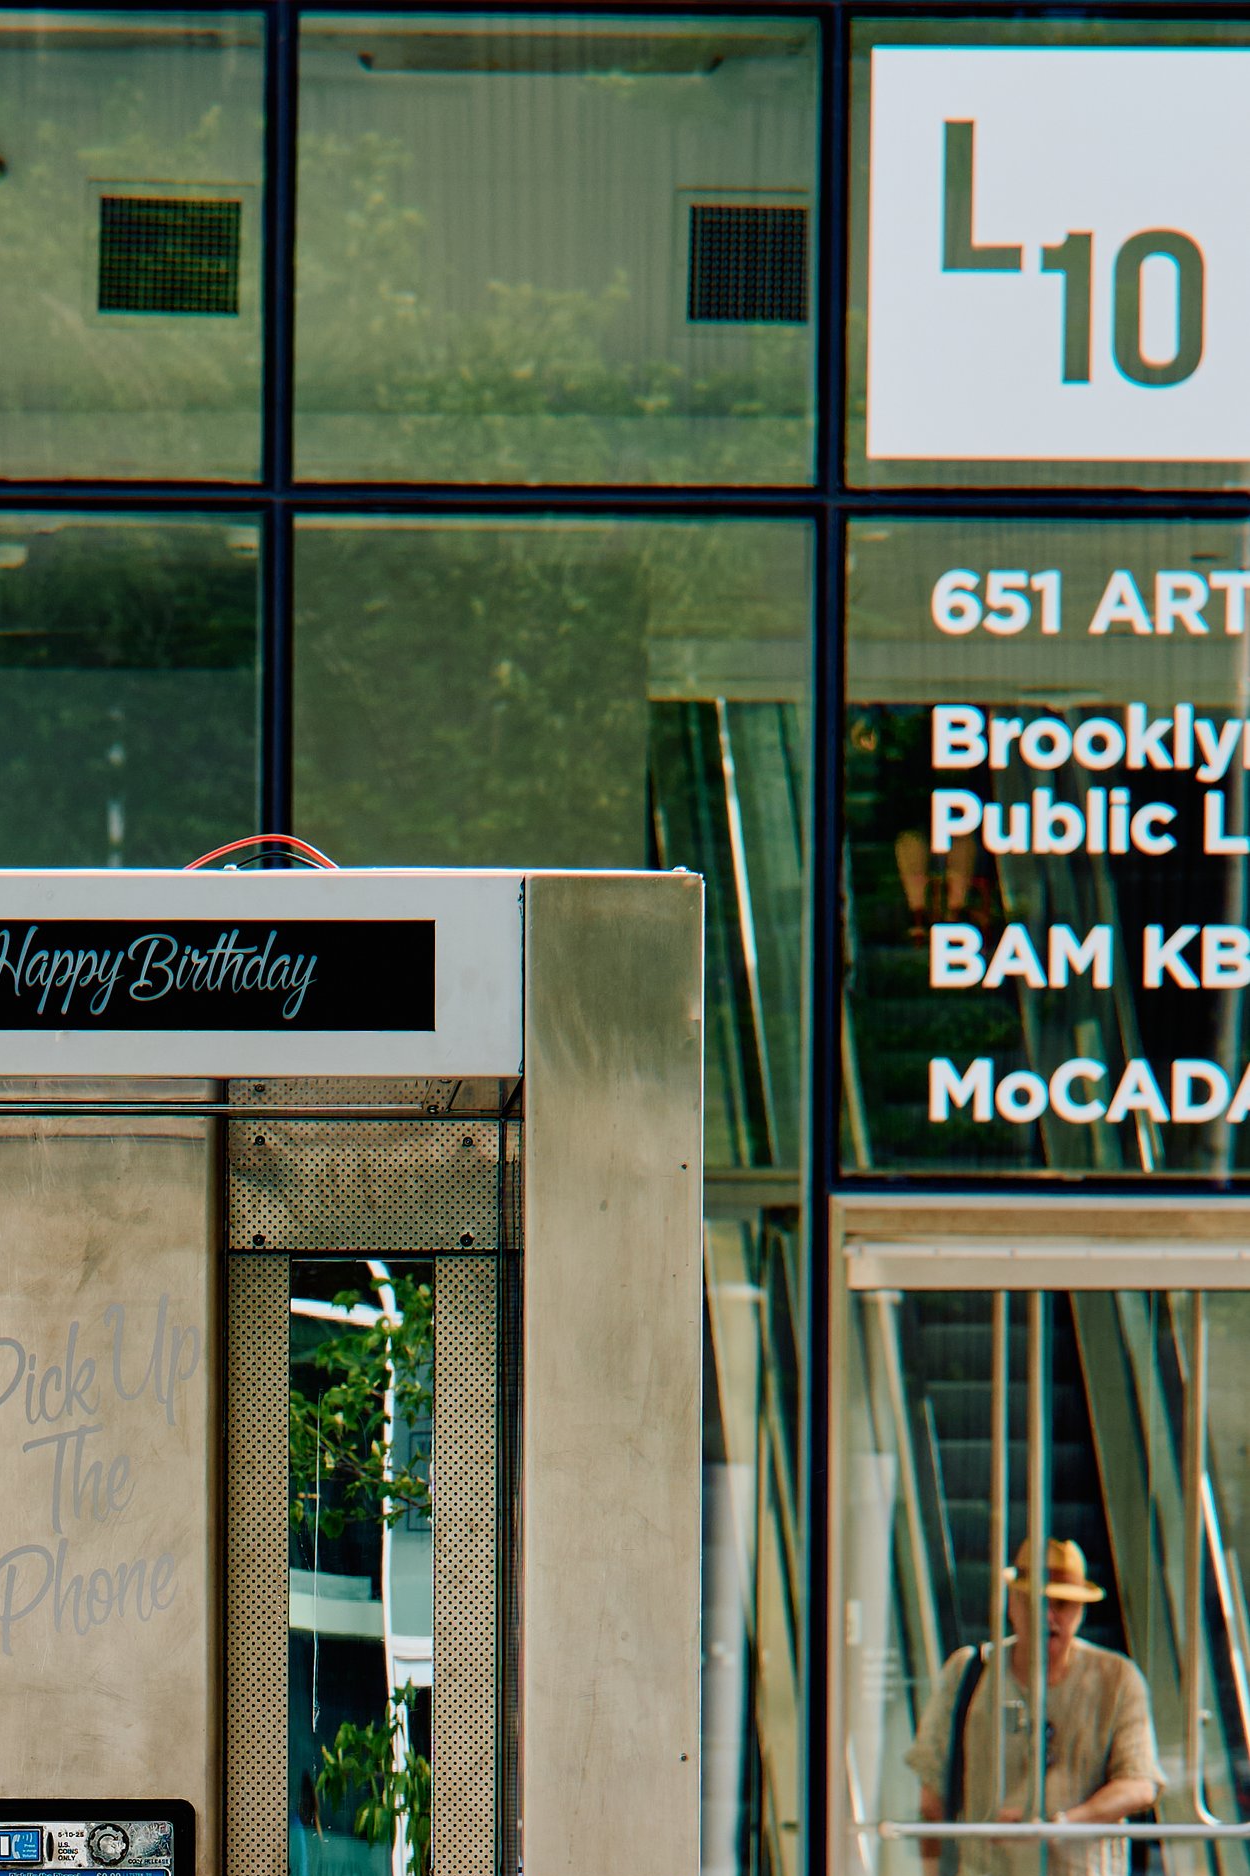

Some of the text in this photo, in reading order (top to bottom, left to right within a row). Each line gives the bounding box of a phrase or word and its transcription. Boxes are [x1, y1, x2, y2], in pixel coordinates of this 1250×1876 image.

[930, 569, 1061, 635] 651
[930, 702, 1250, 781] Brookly
[930, 787, 1177, 855] Public
[128, 929, 317, 1020] Birthday
[929, 923, 1113, 990] BAM
[103, 1293, 201, 1426] Up
[22, 1423, 136, 1535] The
